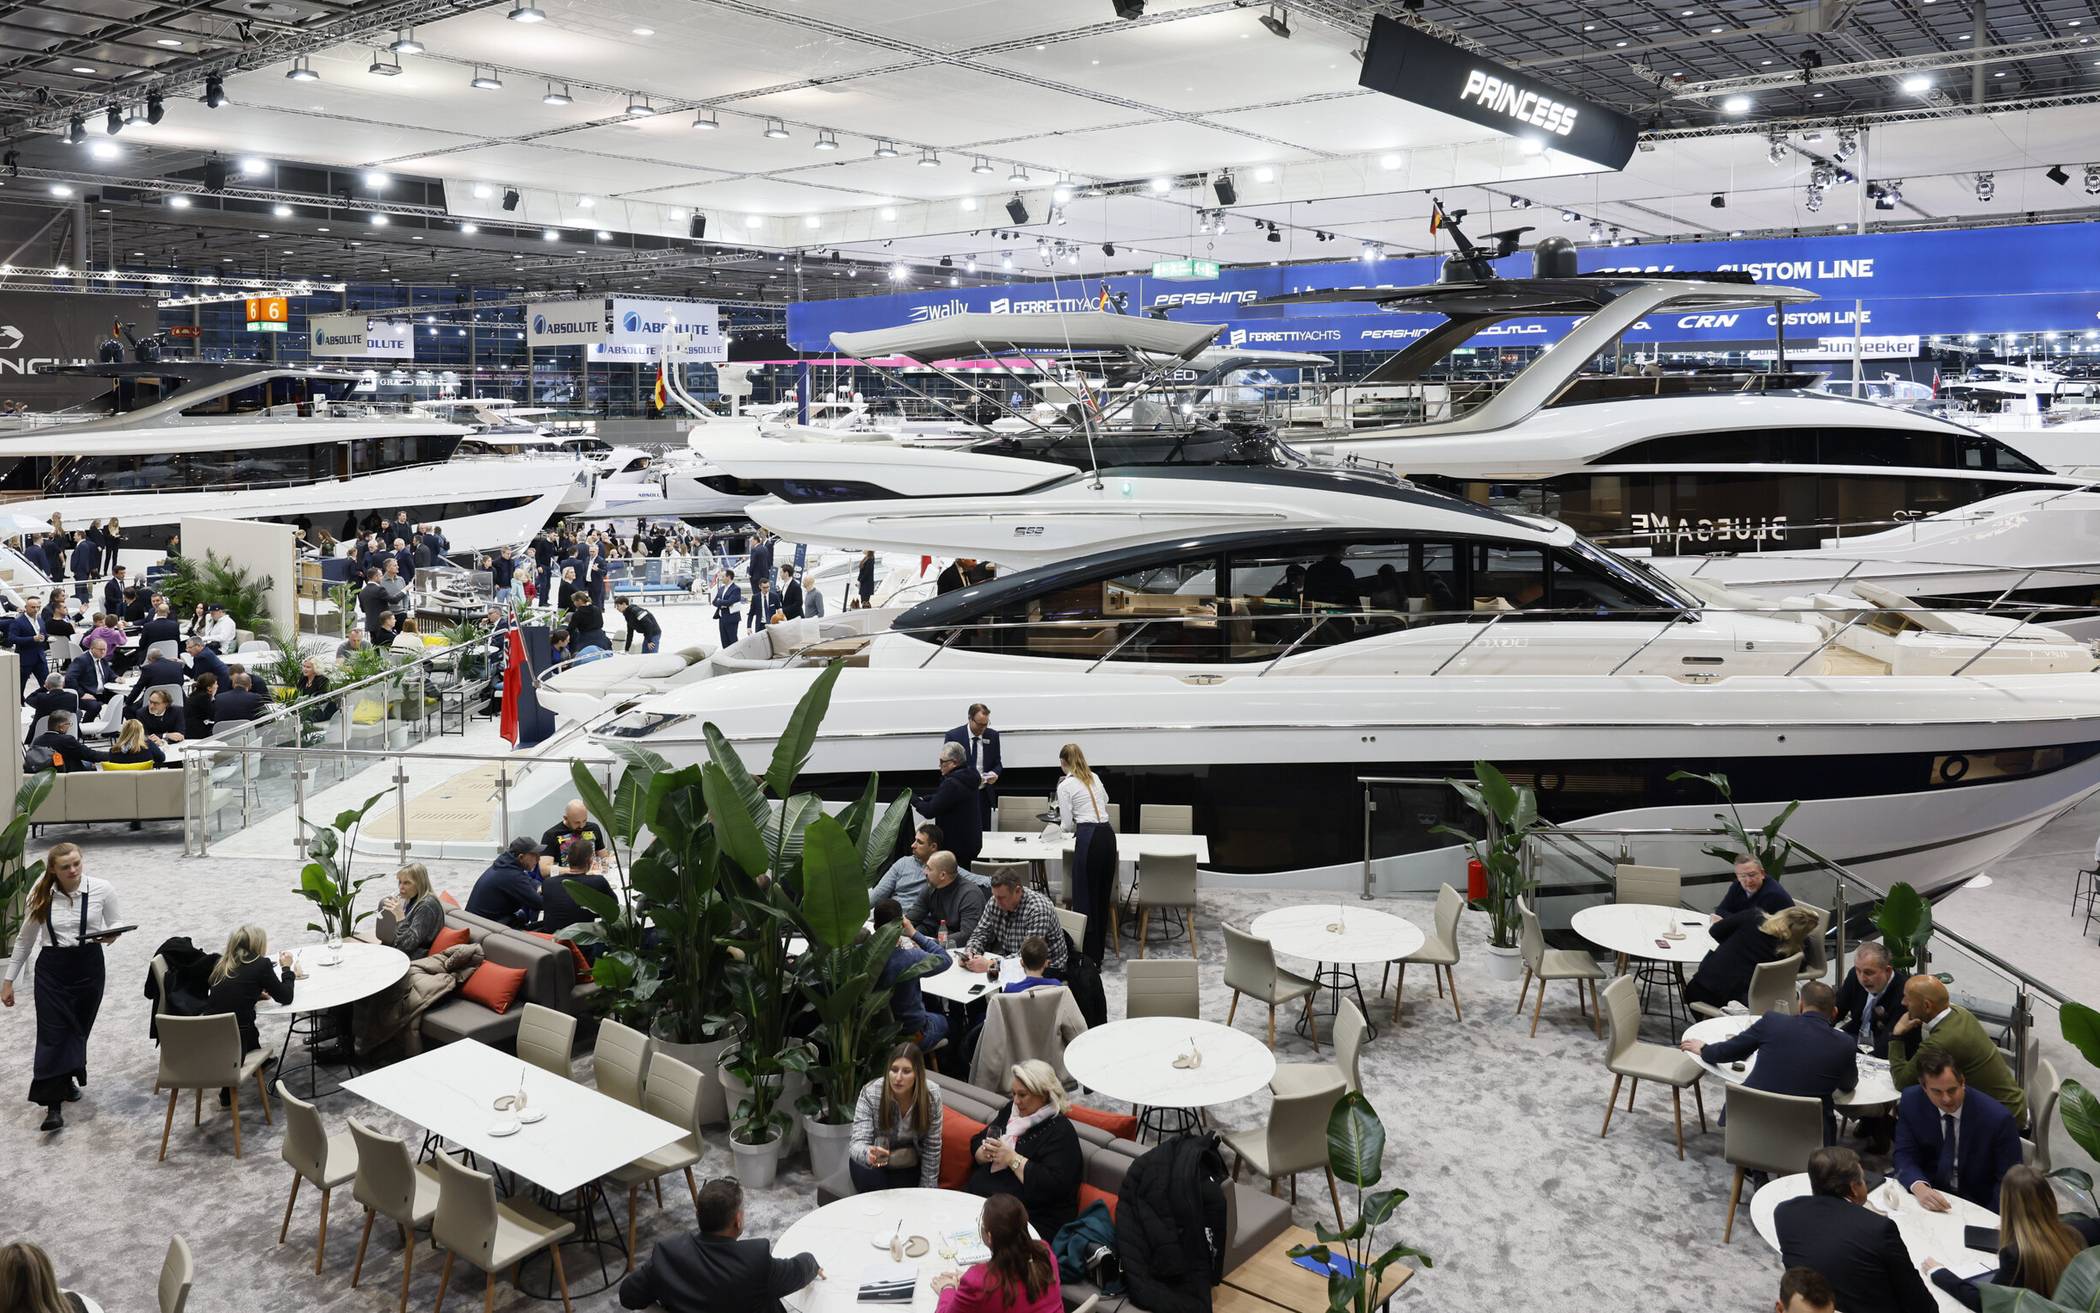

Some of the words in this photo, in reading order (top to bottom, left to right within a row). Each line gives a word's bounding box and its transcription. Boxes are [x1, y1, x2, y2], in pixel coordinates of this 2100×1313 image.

[1460, 70, 1577, 136] PRINCESS
[1818, 258, 1874, 279] LINE
[1154, 290, 1258, 306] PERSHING
[250, 302, 257, 320] 6
[268, 302, 280, 320] 6
[928, 299, 969, 320] wally
[546, 321, 598, 334] ABSOLUTE
[1677, 314, 1740, 329] CRN
[325, 334, 362, 345] ABSOLUTE
[1360, 328, 1435, 340] PERSHIN
[607, 346, 657, 355] ABSOLUTE
[687, 345, 722, 354] BSOLUTE
